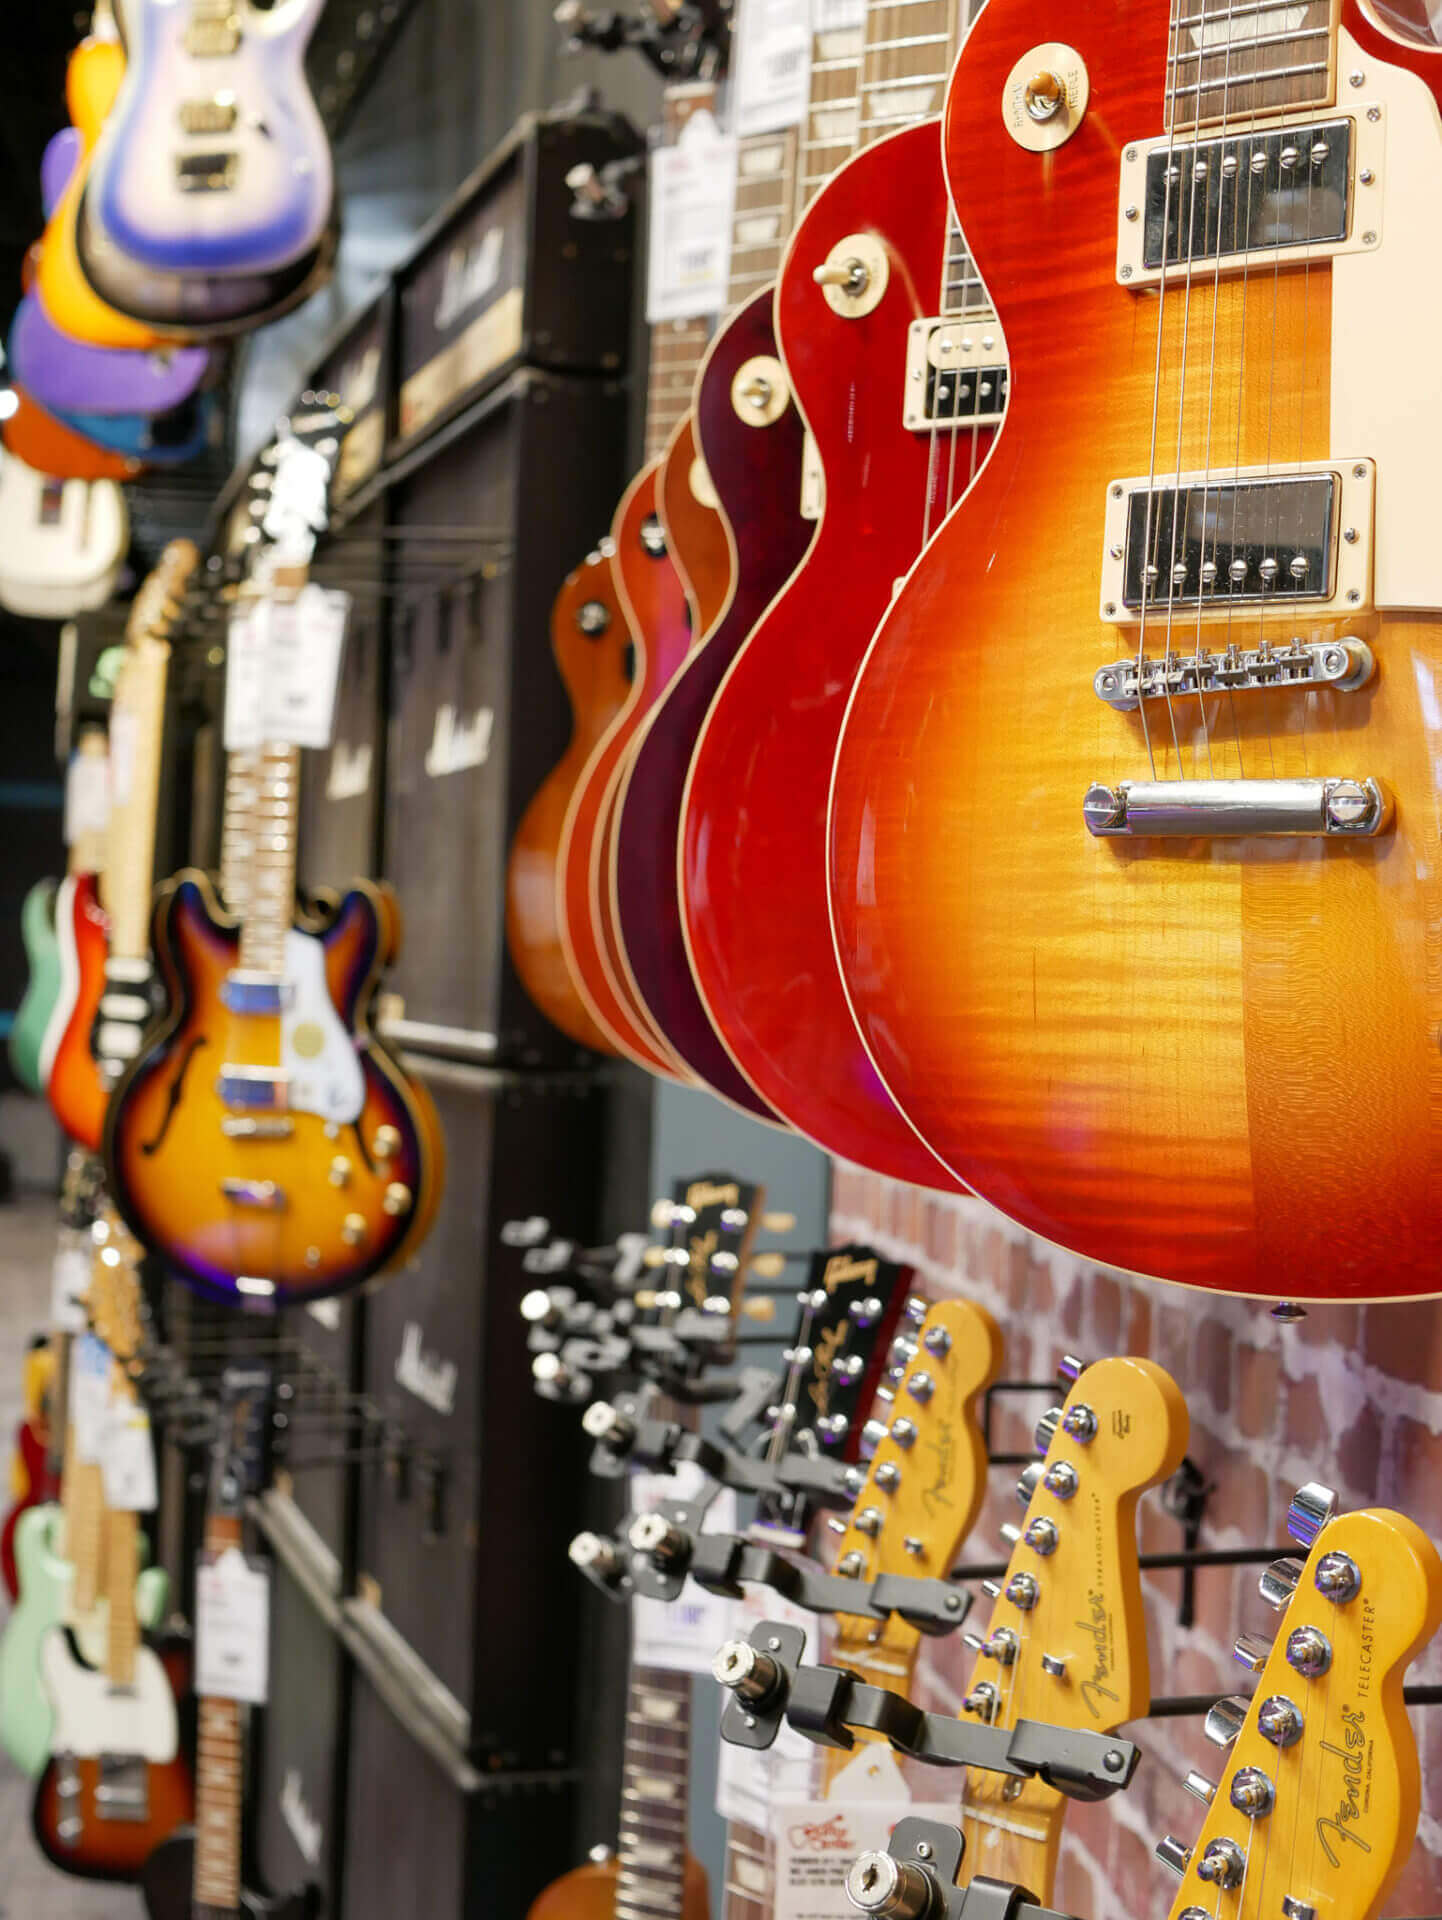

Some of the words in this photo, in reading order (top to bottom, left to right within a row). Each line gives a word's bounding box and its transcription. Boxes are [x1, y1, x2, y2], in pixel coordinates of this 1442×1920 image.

[1076, 1592, 1119, 1718] Fender
[1356, 1604, 1376, 1699] TELECASTER
[1315, 1710, 1372, 1868] Fender
